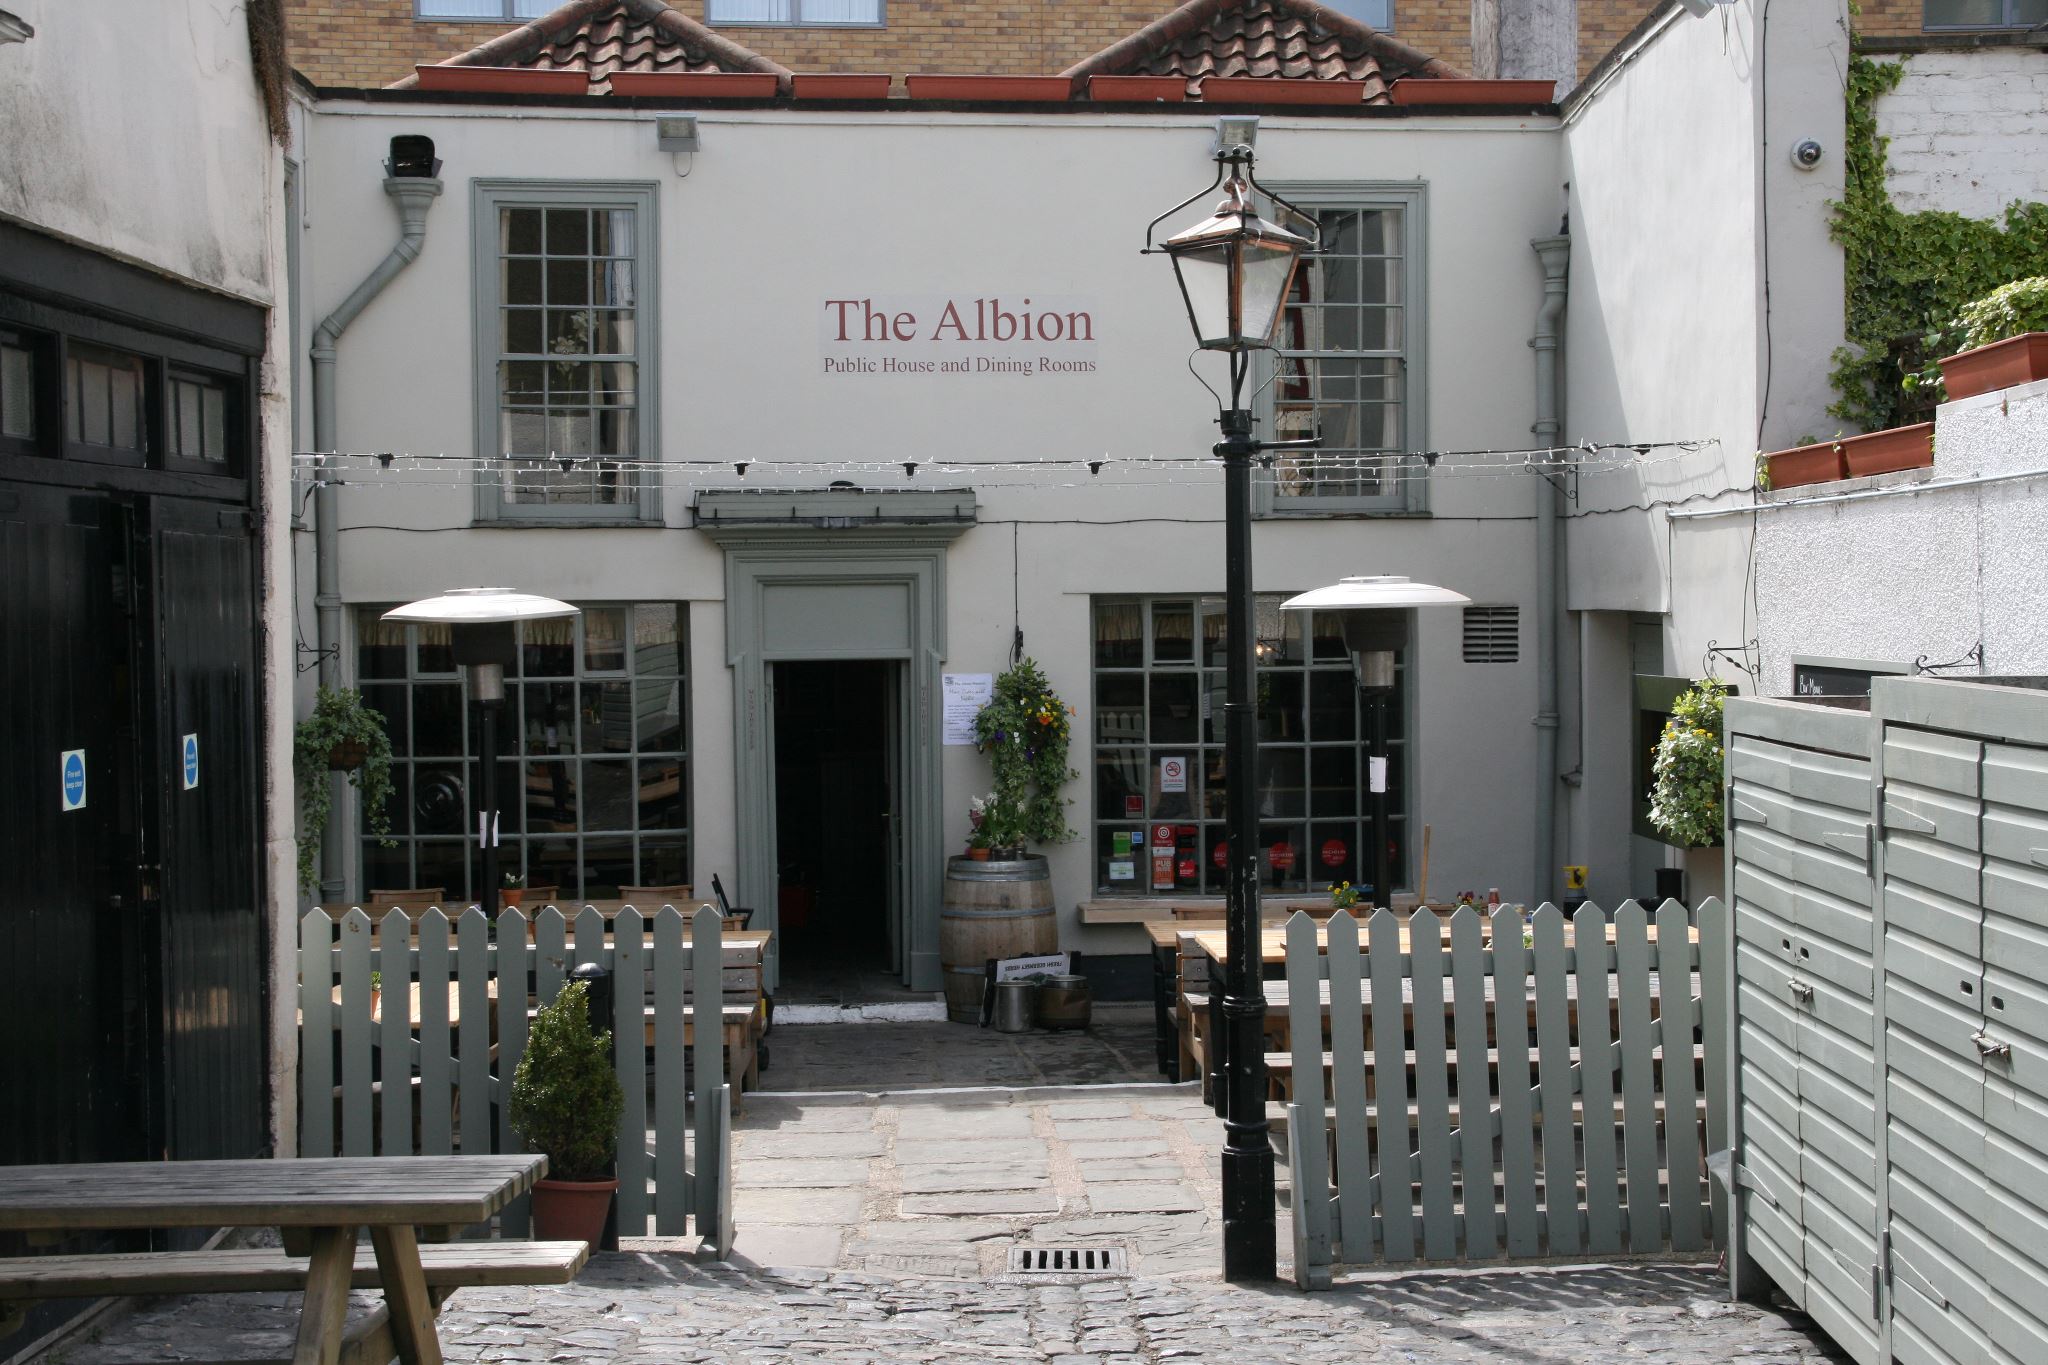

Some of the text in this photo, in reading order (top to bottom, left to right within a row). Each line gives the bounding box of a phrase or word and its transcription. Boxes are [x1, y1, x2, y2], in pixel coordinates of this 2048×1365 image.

[825, 298, 1095, 341] The Albion
[824, 356, 1096, 376] Public House and Dining Rooms
